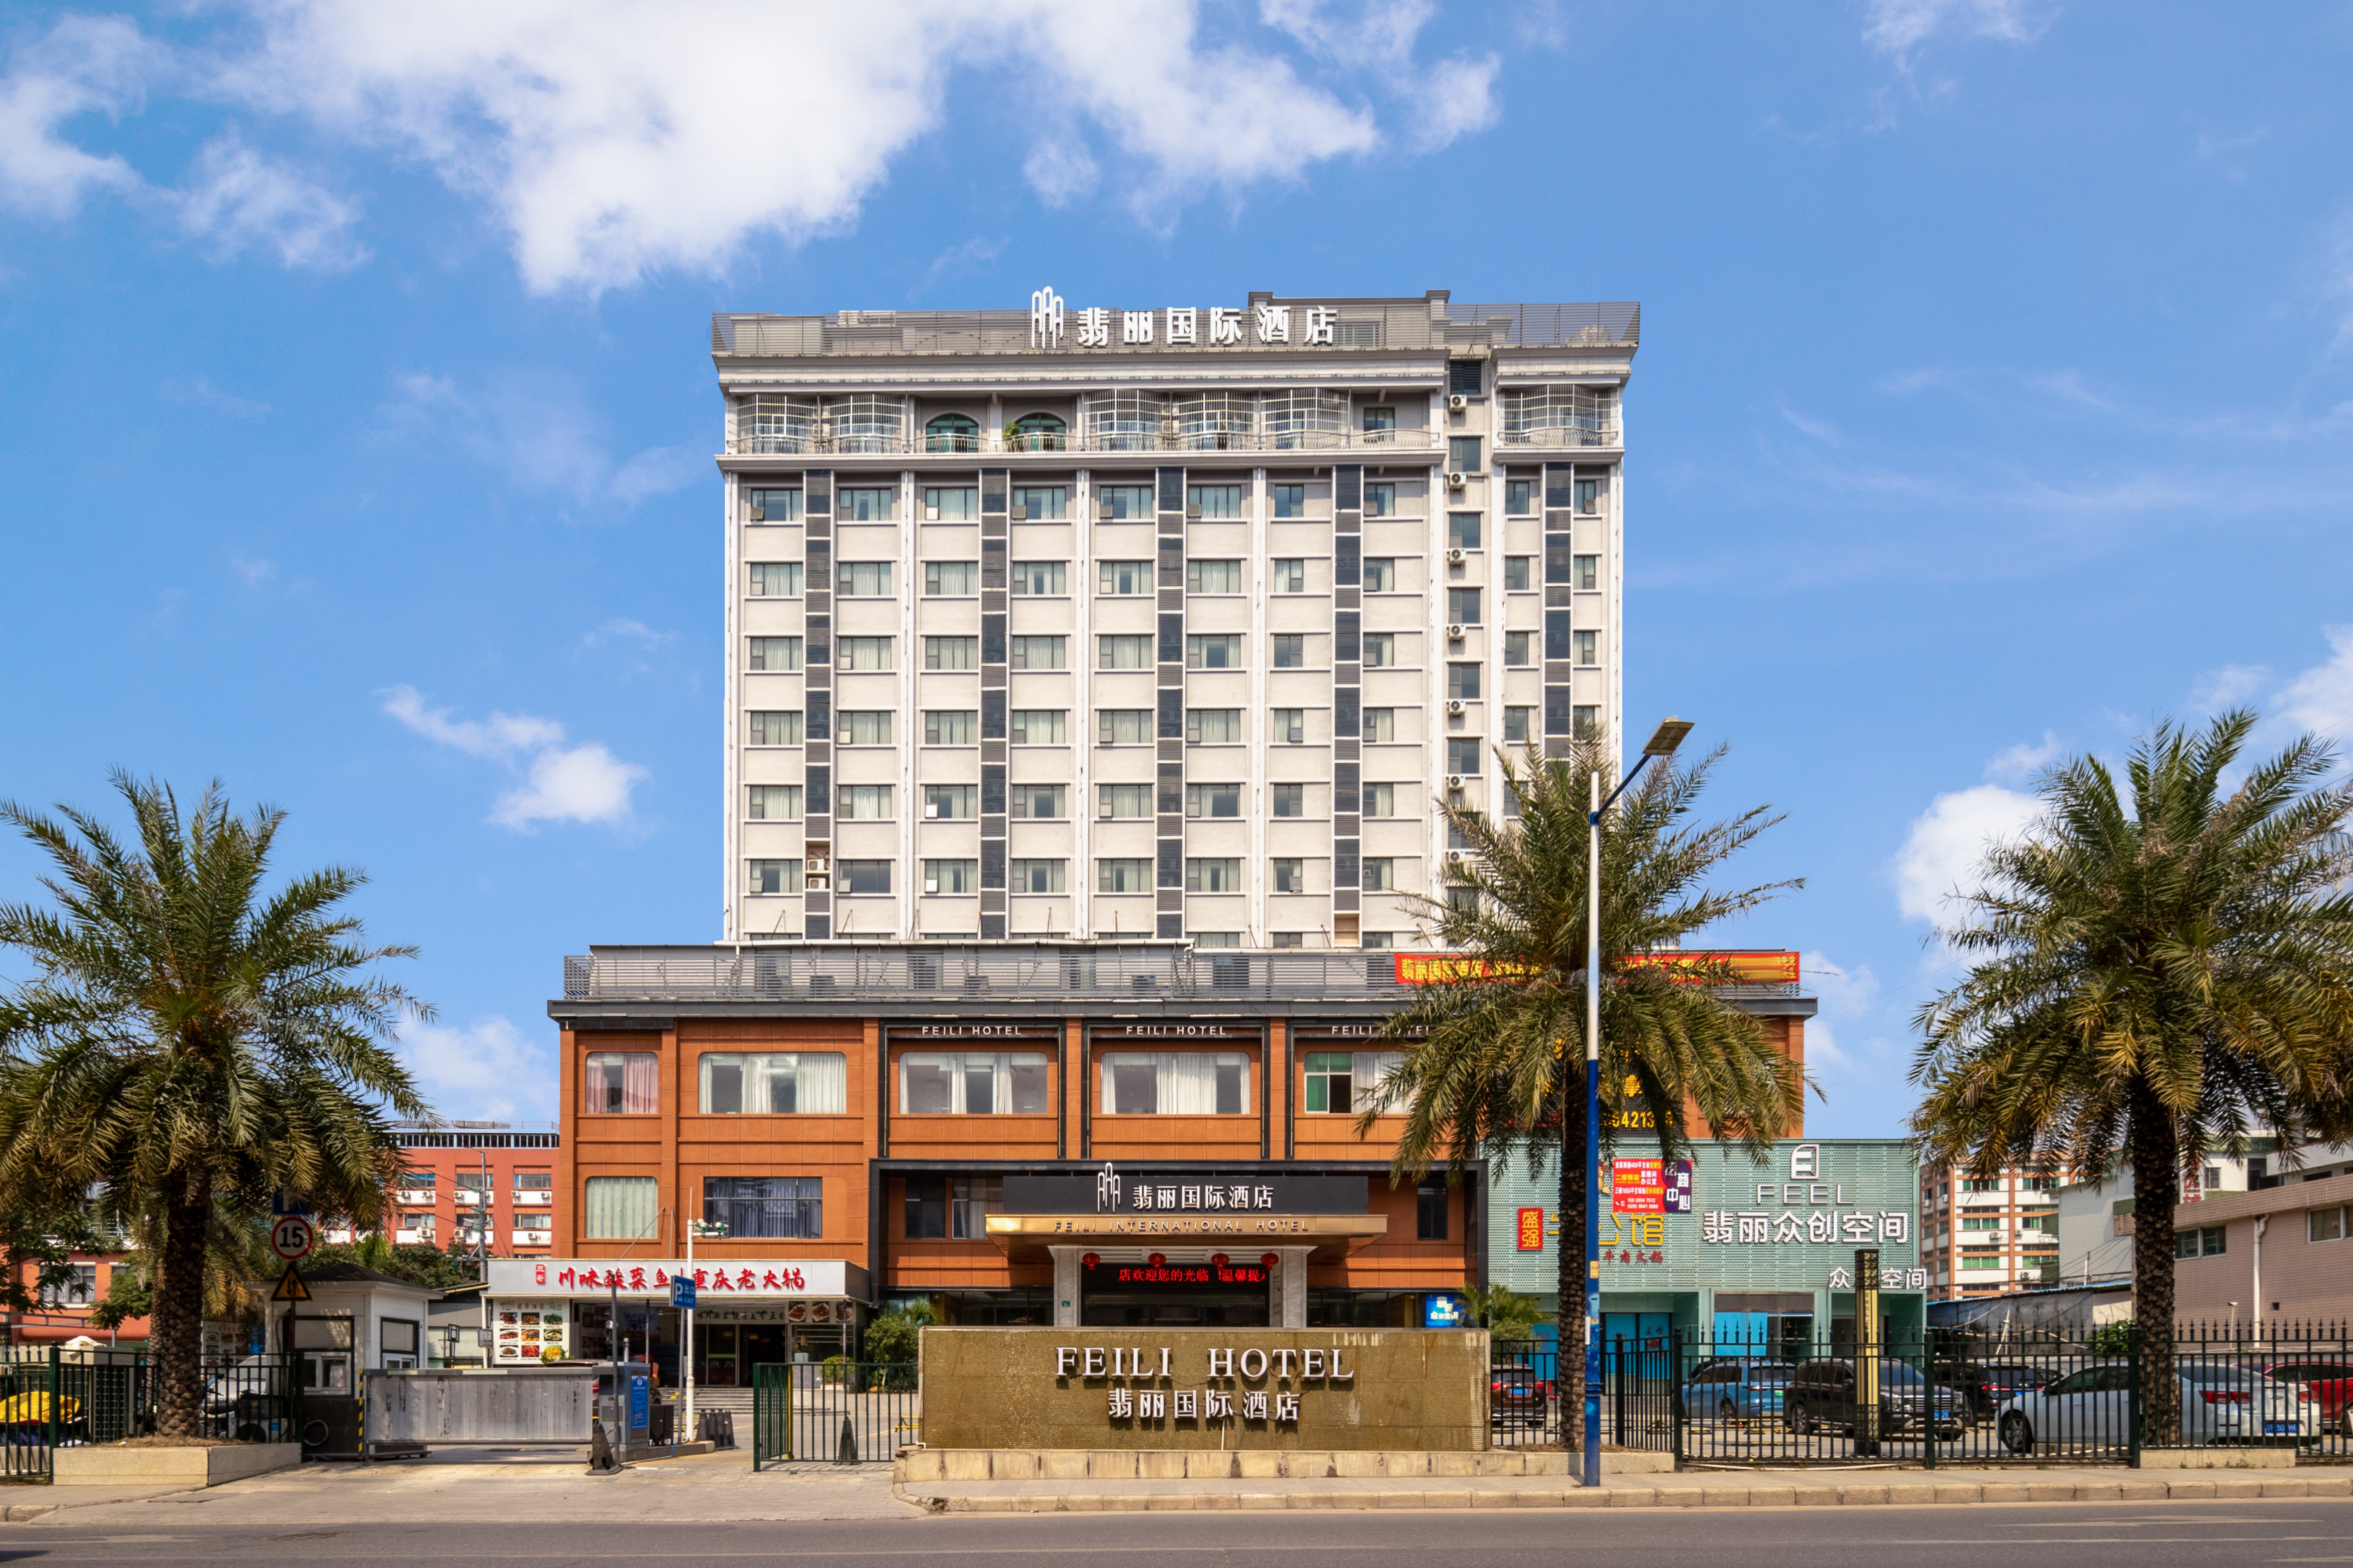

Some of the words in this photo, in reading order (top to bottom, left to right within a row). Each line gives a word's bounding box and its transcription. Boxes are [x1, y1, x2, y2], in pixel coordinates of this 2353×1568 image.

[1077, 306, 1337, 346] 翡丽国际酒店
[922, 1026, 962, 1035] FEILI
[972, 1026, 1021, 1035] HOTEL
[1126, 1026, 1166, 1035] FEILI
[1177, 1026, 1226, 1035] HOTEL
[1332, 1026, 1372, 1035] FEILI
[1132, 1185, 1274, 1209] 翡丽国际酒店
[1757, 1184, 1854, 1204] FEEL
[1055, 1221, 1096, 1232] FEILI
[1109, 1221, 1243, 1232] INTERNATIONAL
[1257, 1220, 1309, 1230] HOTEL
[1522, 1211, 1539, 1247] 盛强
[1703, 1210, 1908, 1244] 翡丽众创空间
[279, 1226, 304, 1248] 15
[1603, 1248, 1664, 1264] 牛肉火锅
[558, 1266, 671, 1290] 川味酸菜鱼
[692, 1267, 805, 1290] 重庆老火锅
[1118, 1268, 1209, 1282] 店欢迎您的光临
[1829, 1266, 1927, 1290] 众空间
[675, 1282, 684, 1302] P
[684, 1285, 695, 1295] 出口
[1055, 1347, 1172, 1377] FEILI
[1207, 1348, 1354, 1378] HOTEL
[1108, 1388, 1300, 1421] 翡丽国际酒店
